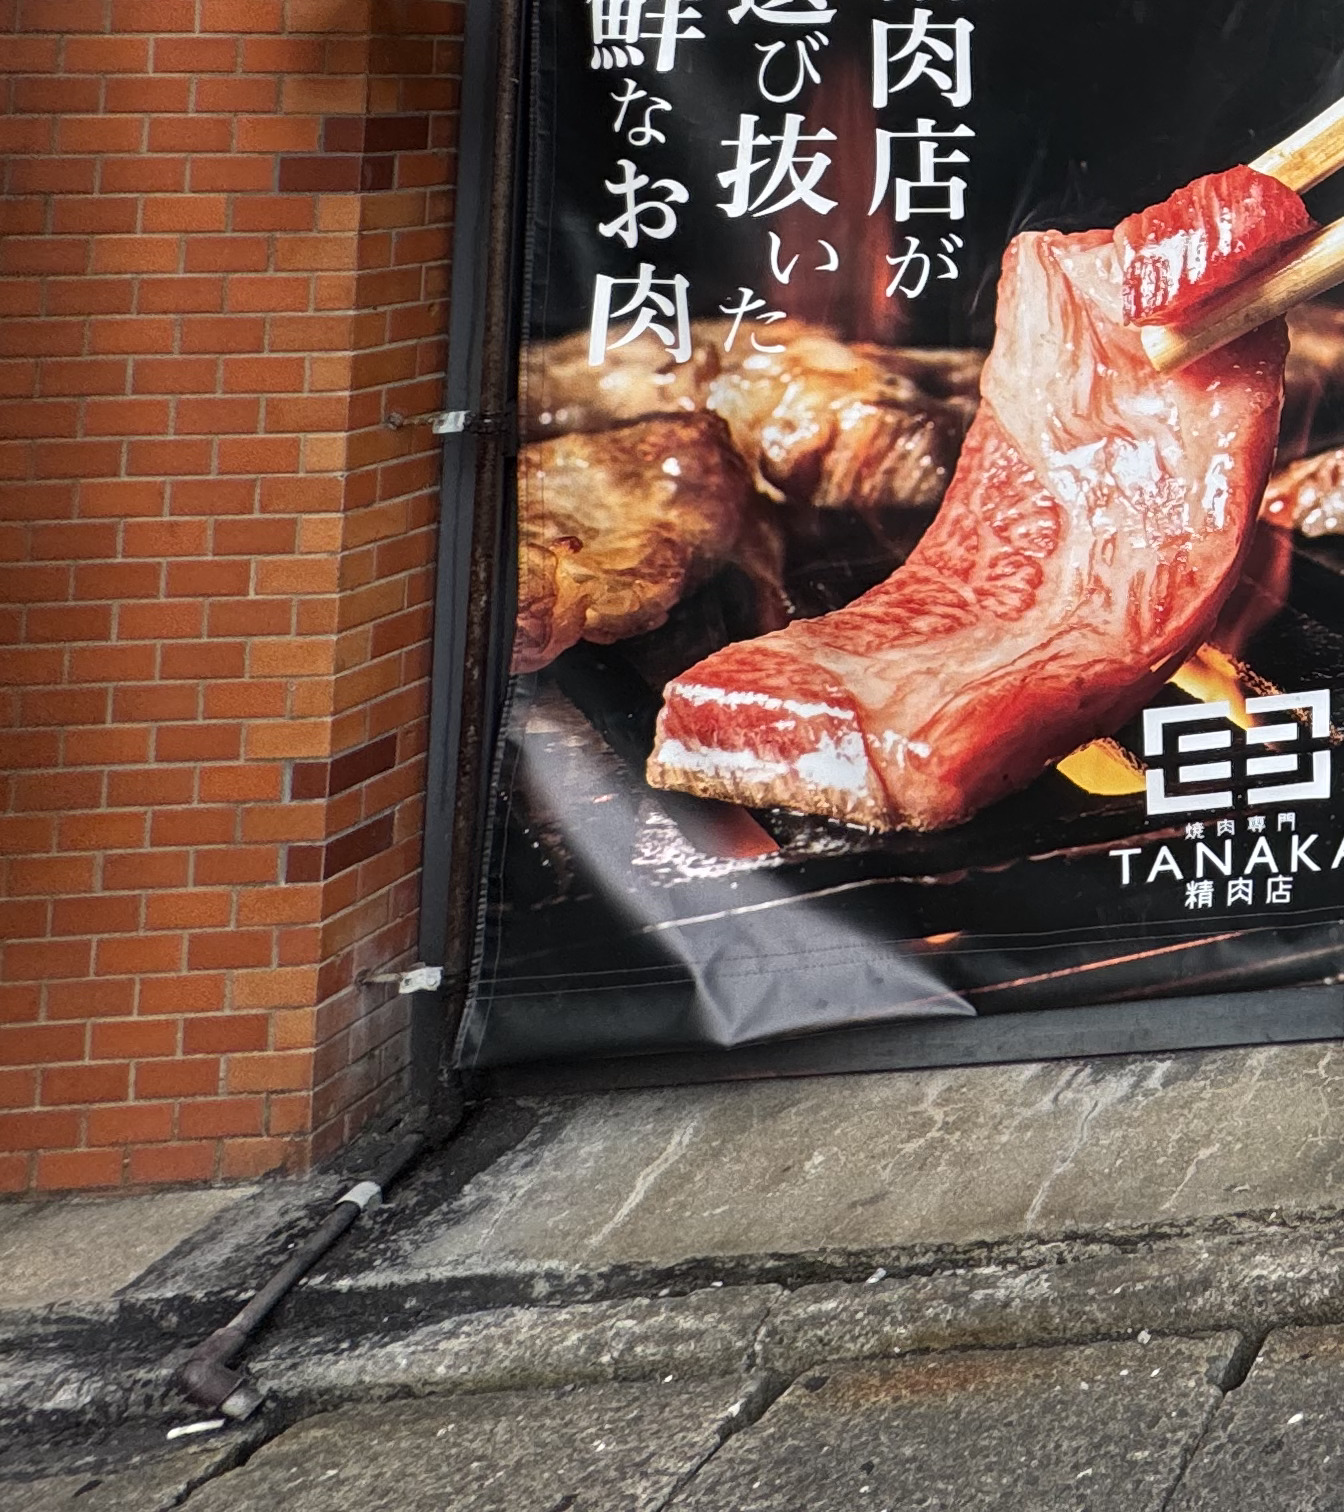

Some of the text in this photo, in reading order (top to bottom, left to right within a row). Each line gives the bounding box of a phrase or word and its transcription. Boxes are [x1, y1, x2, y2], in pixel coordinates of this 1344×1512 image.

[1184, 811, 1297, 841] 焼肉専門
[1184, 874, 1294, 910] 精肉店
